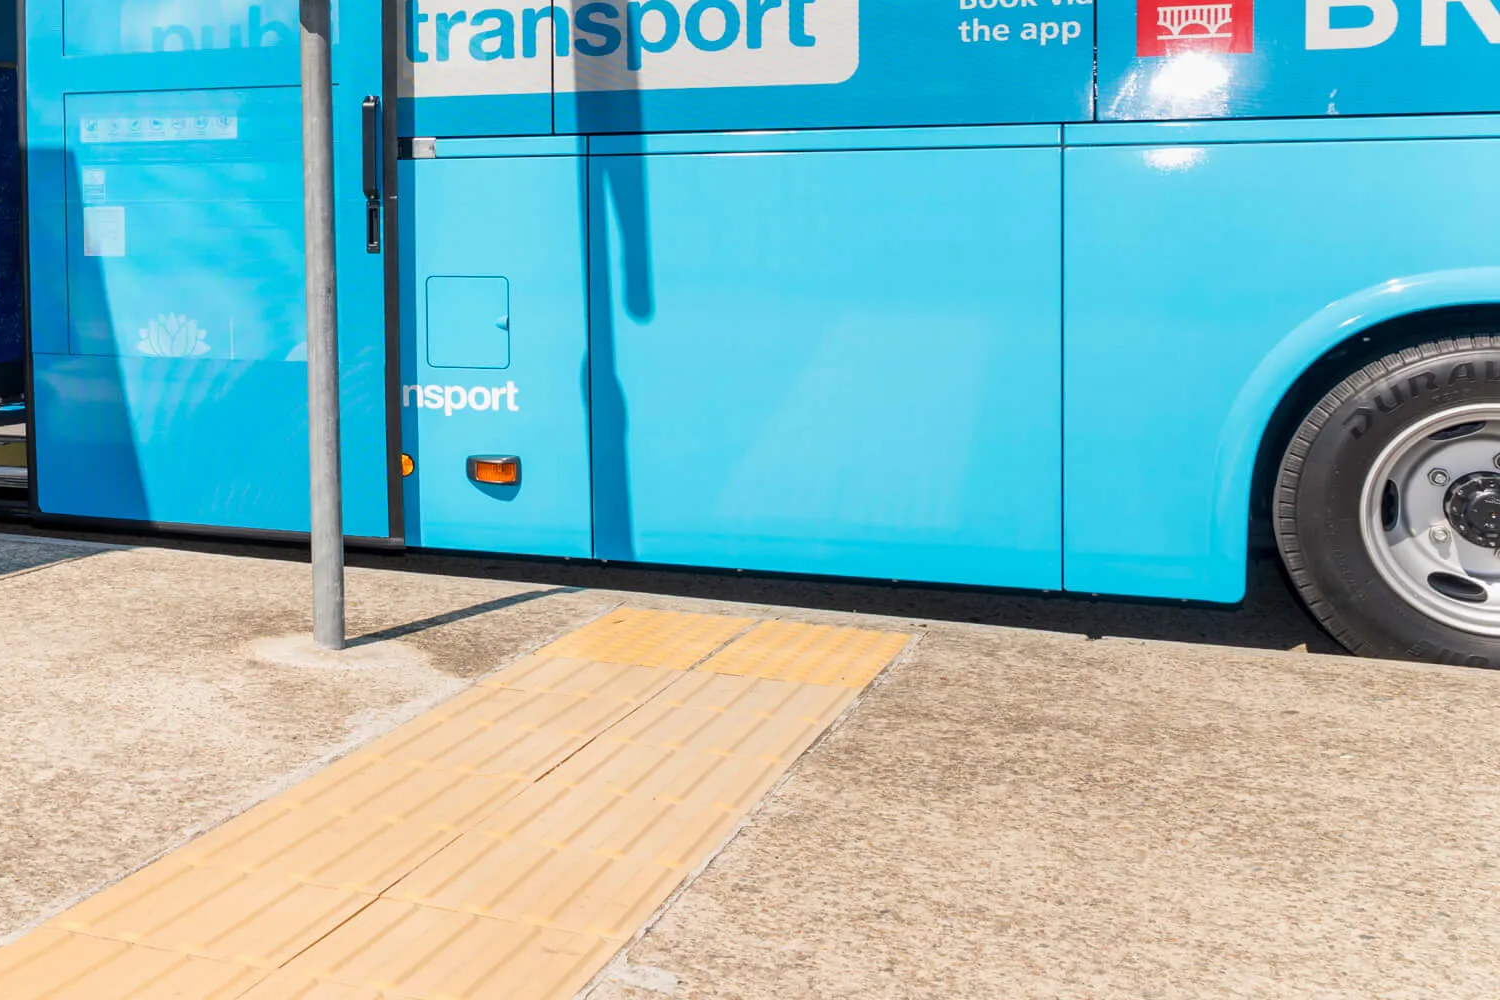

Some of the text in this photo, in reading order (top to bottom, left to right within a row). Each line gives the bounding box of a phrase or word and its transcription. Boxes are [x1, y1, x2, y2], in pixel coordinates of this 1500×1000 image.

[957, 17, 1082, 47] the app
[402, 380, 520, 417] nsport
